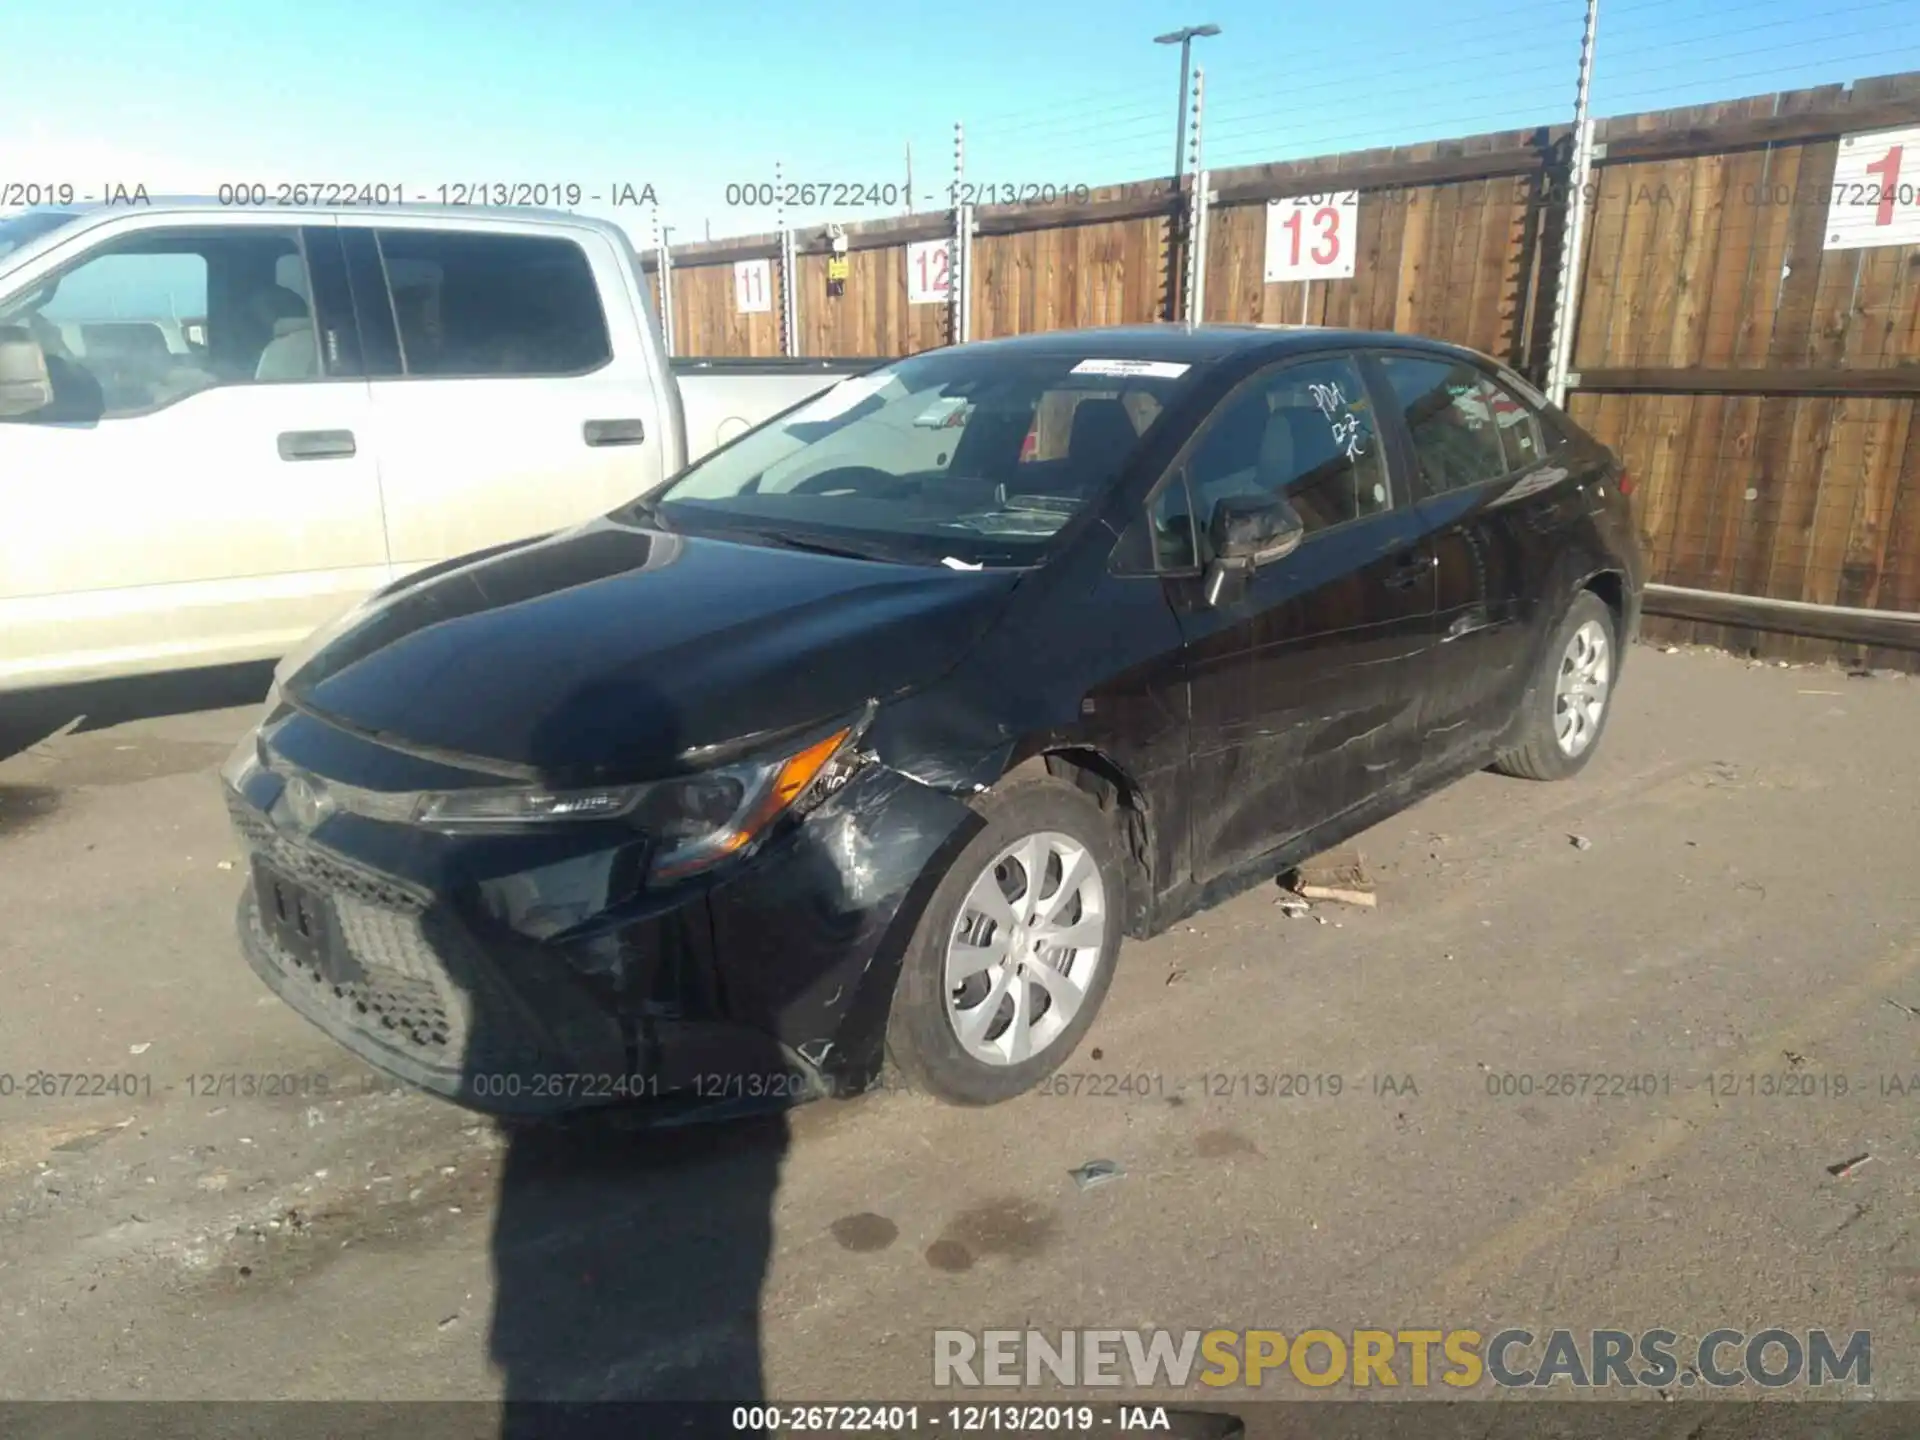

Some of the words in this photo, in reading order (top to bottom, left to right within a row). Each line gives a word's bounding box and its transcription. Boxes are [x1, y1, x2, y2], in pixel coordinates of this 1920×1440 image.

[1283, 207, 1340, 266] 13
[742, 267, 762, 303] 11
[917, 248, 949, 292] 12
